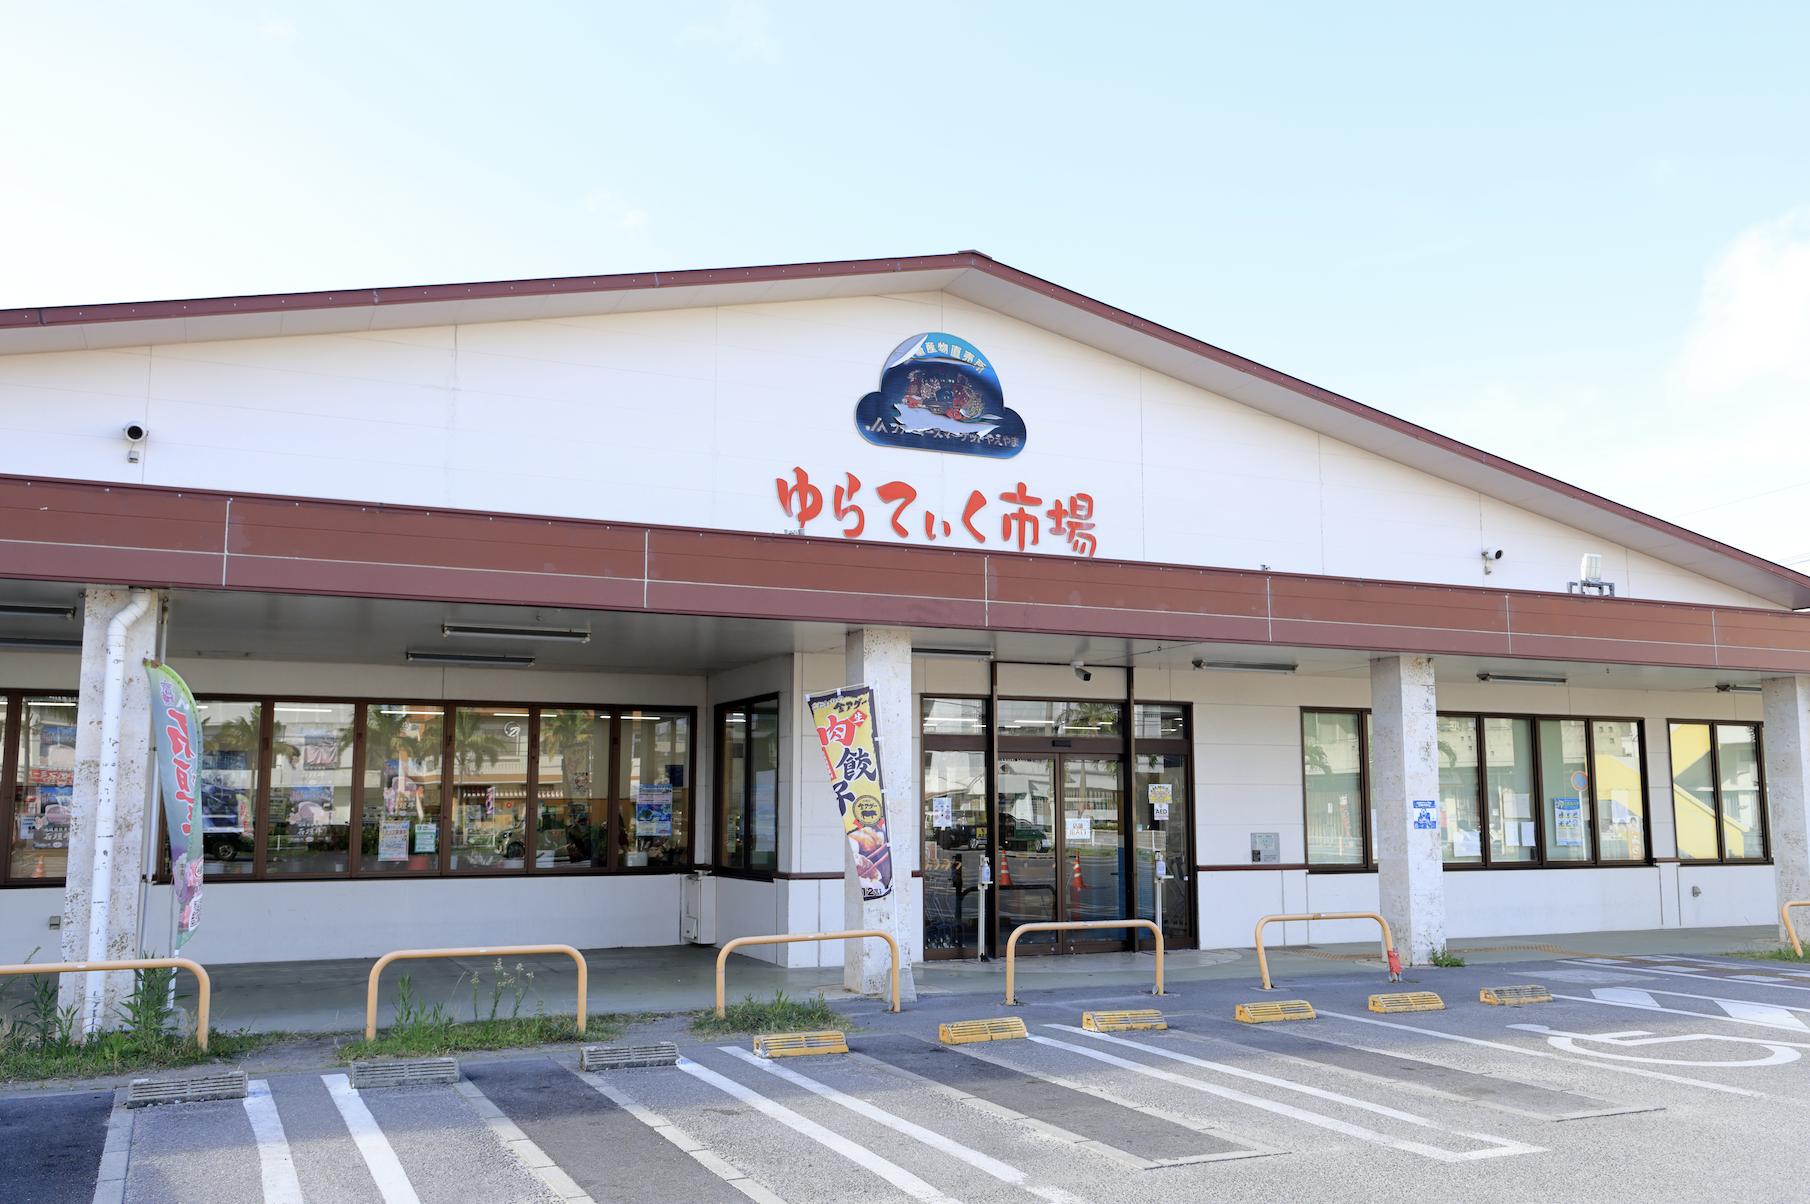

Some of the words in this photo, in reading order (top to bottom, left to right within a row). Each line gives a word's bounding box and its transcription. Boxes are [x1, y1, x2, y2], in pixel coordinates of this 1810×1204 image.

[776, 465, 1097, 558] ゆらてぃく市場
